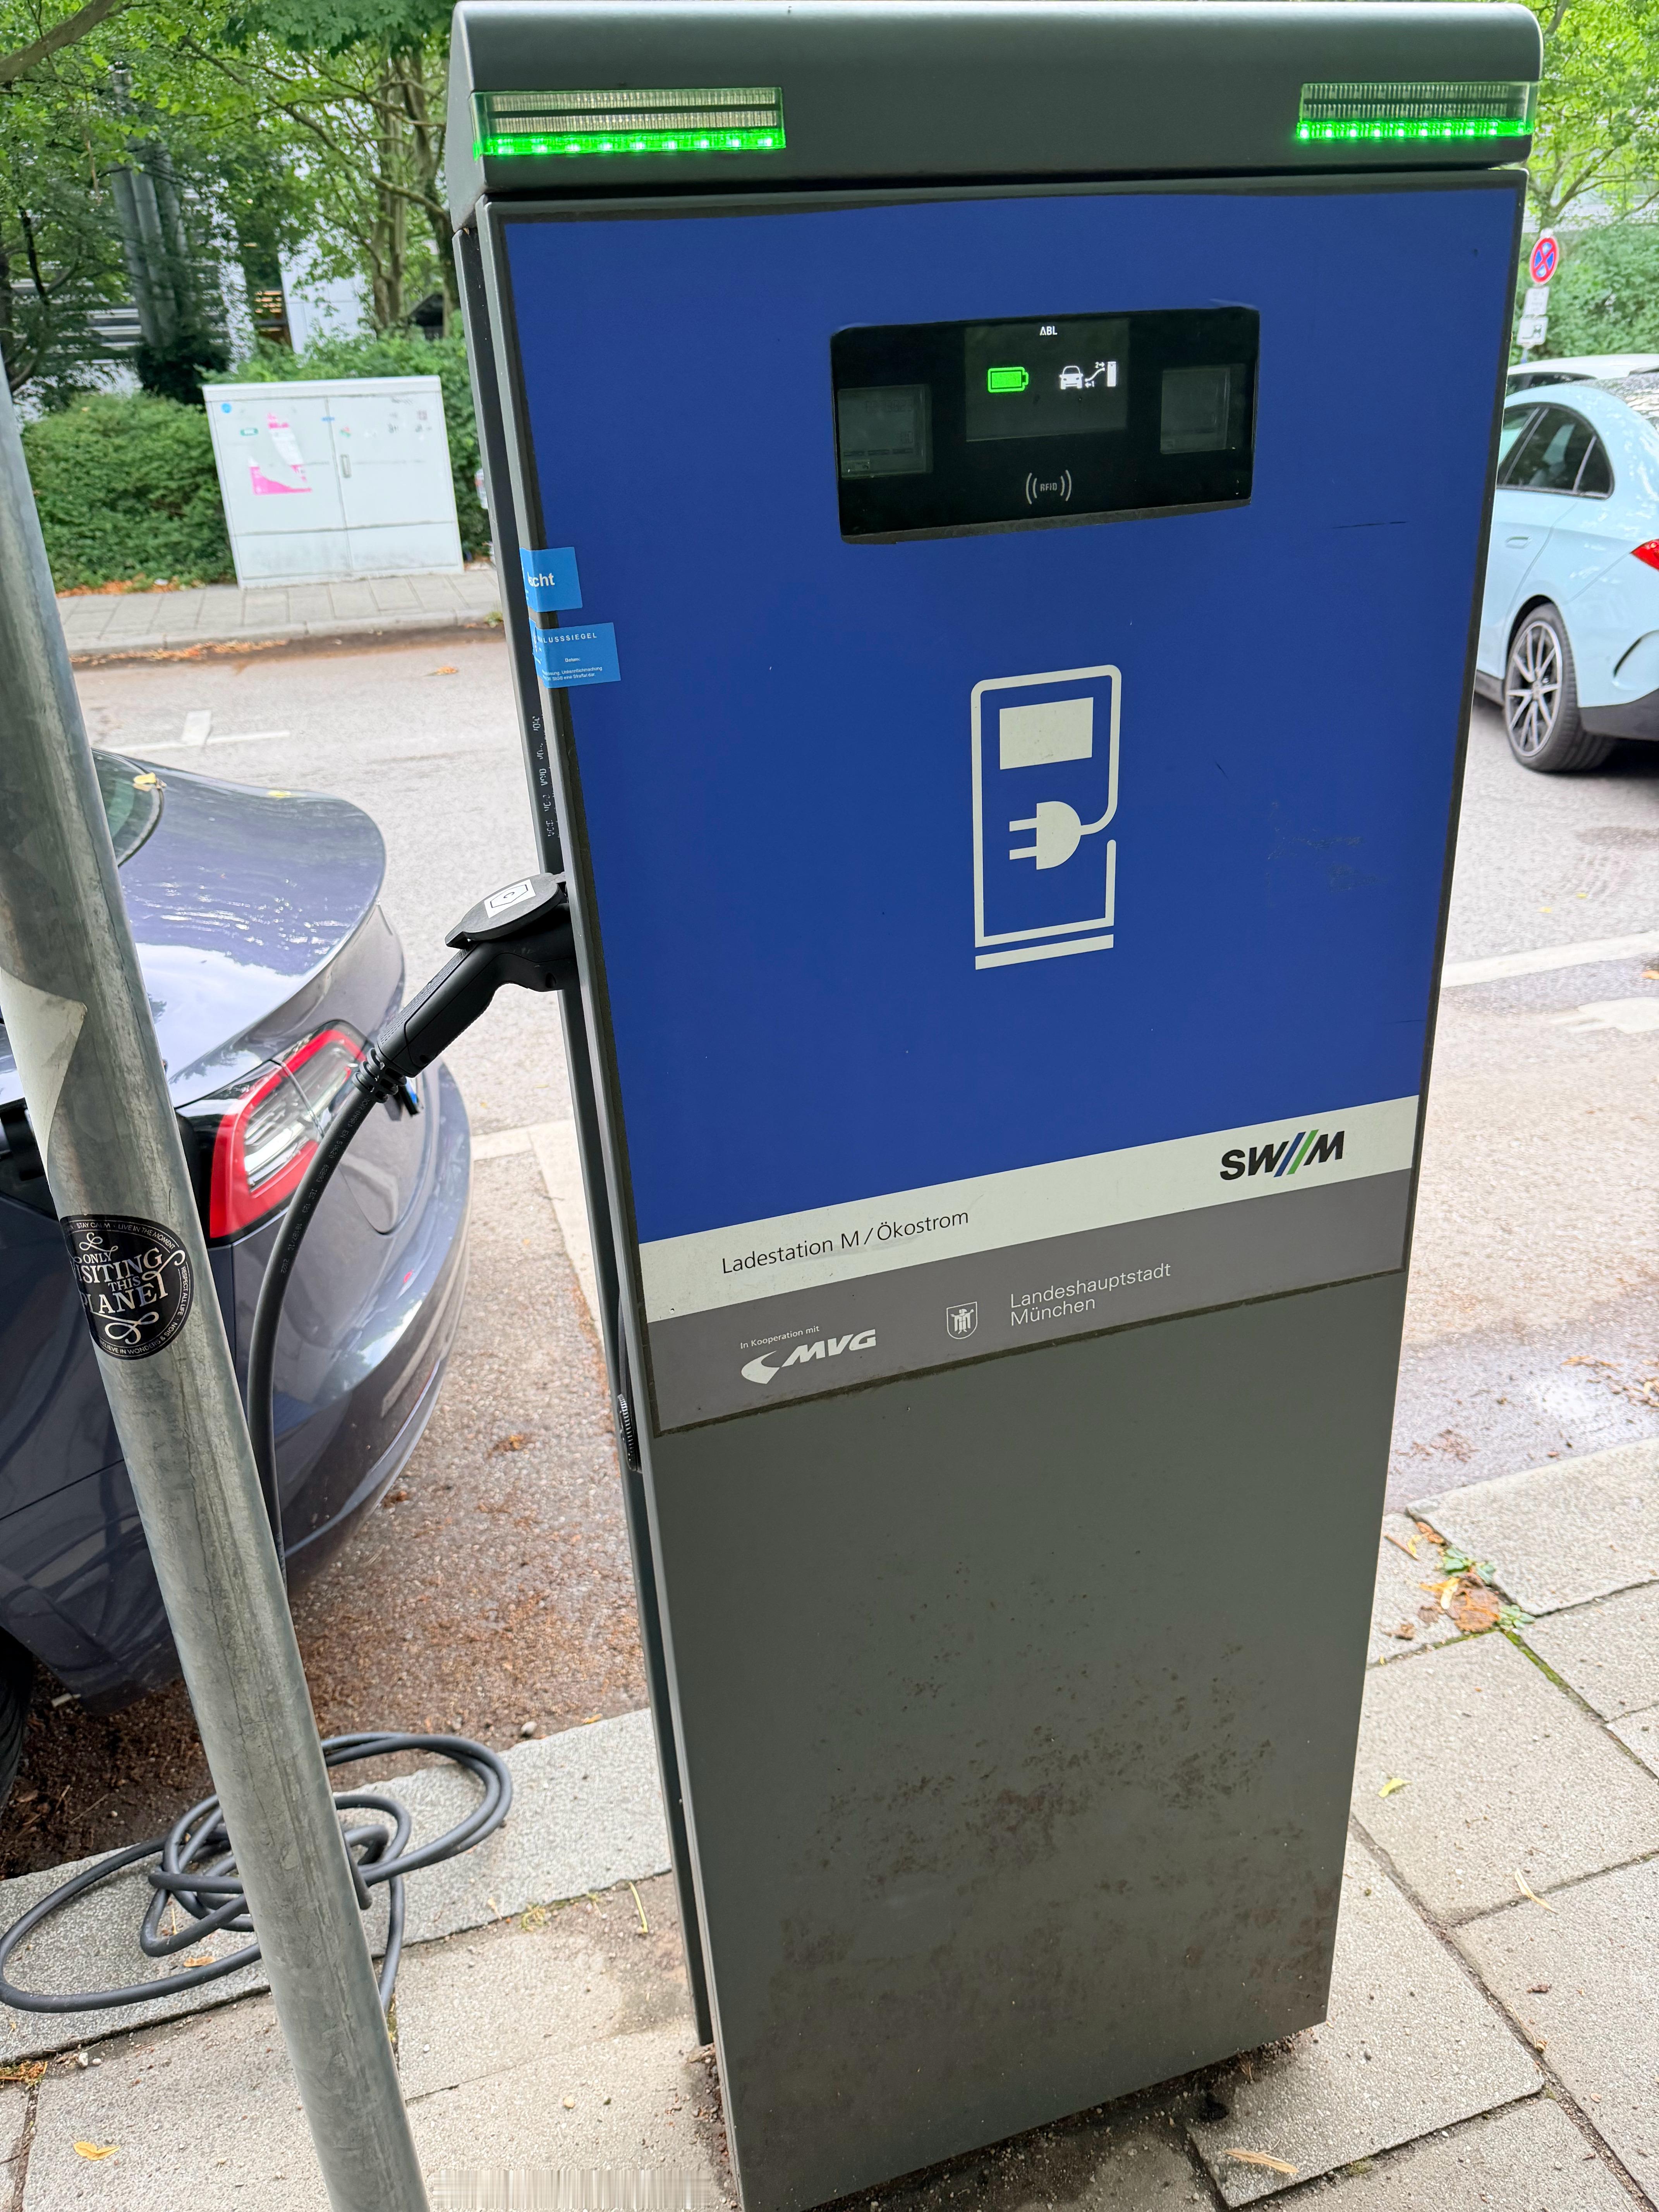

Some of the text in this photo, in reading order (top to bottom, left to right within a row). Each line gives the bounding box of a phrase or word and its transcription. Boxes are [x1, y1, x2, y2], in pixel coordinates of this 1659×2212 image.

[1040, 326, 1058, 336] ABL
[1040, 483, 1057, 492] RFID
[543, 633, 597, 643] LUSSSIEGEL
[142, 1227, 154, 1236] THE
[152, 1231, 175, 1250] MOMENT
[722, 1238, 833, 1274] Ladestation
[877, 1211, 969, 1240] Ökostrom
[74, 1248, 162, 1283] ISITING
[83, 1252, 112, 1264] ONLY
[108, 1276, 141, 1292] THIS
[1011, 1262, 1171, 1309] Landeshauptstadt
[177, 1304, 186, 1316] LIFE
[1011, 1297, 1096, 1326] München
[101, 1341, 118, 1353] ELIEVE
[127, 1340, 161, 1354] WONDERS
[164, 1322, 178, 1337] SIGN
[751, 1329, 803, 1347] Kooperation
[805, 1326, 820, 1334] mit
[780, 1329, 876, 1367] MVG
